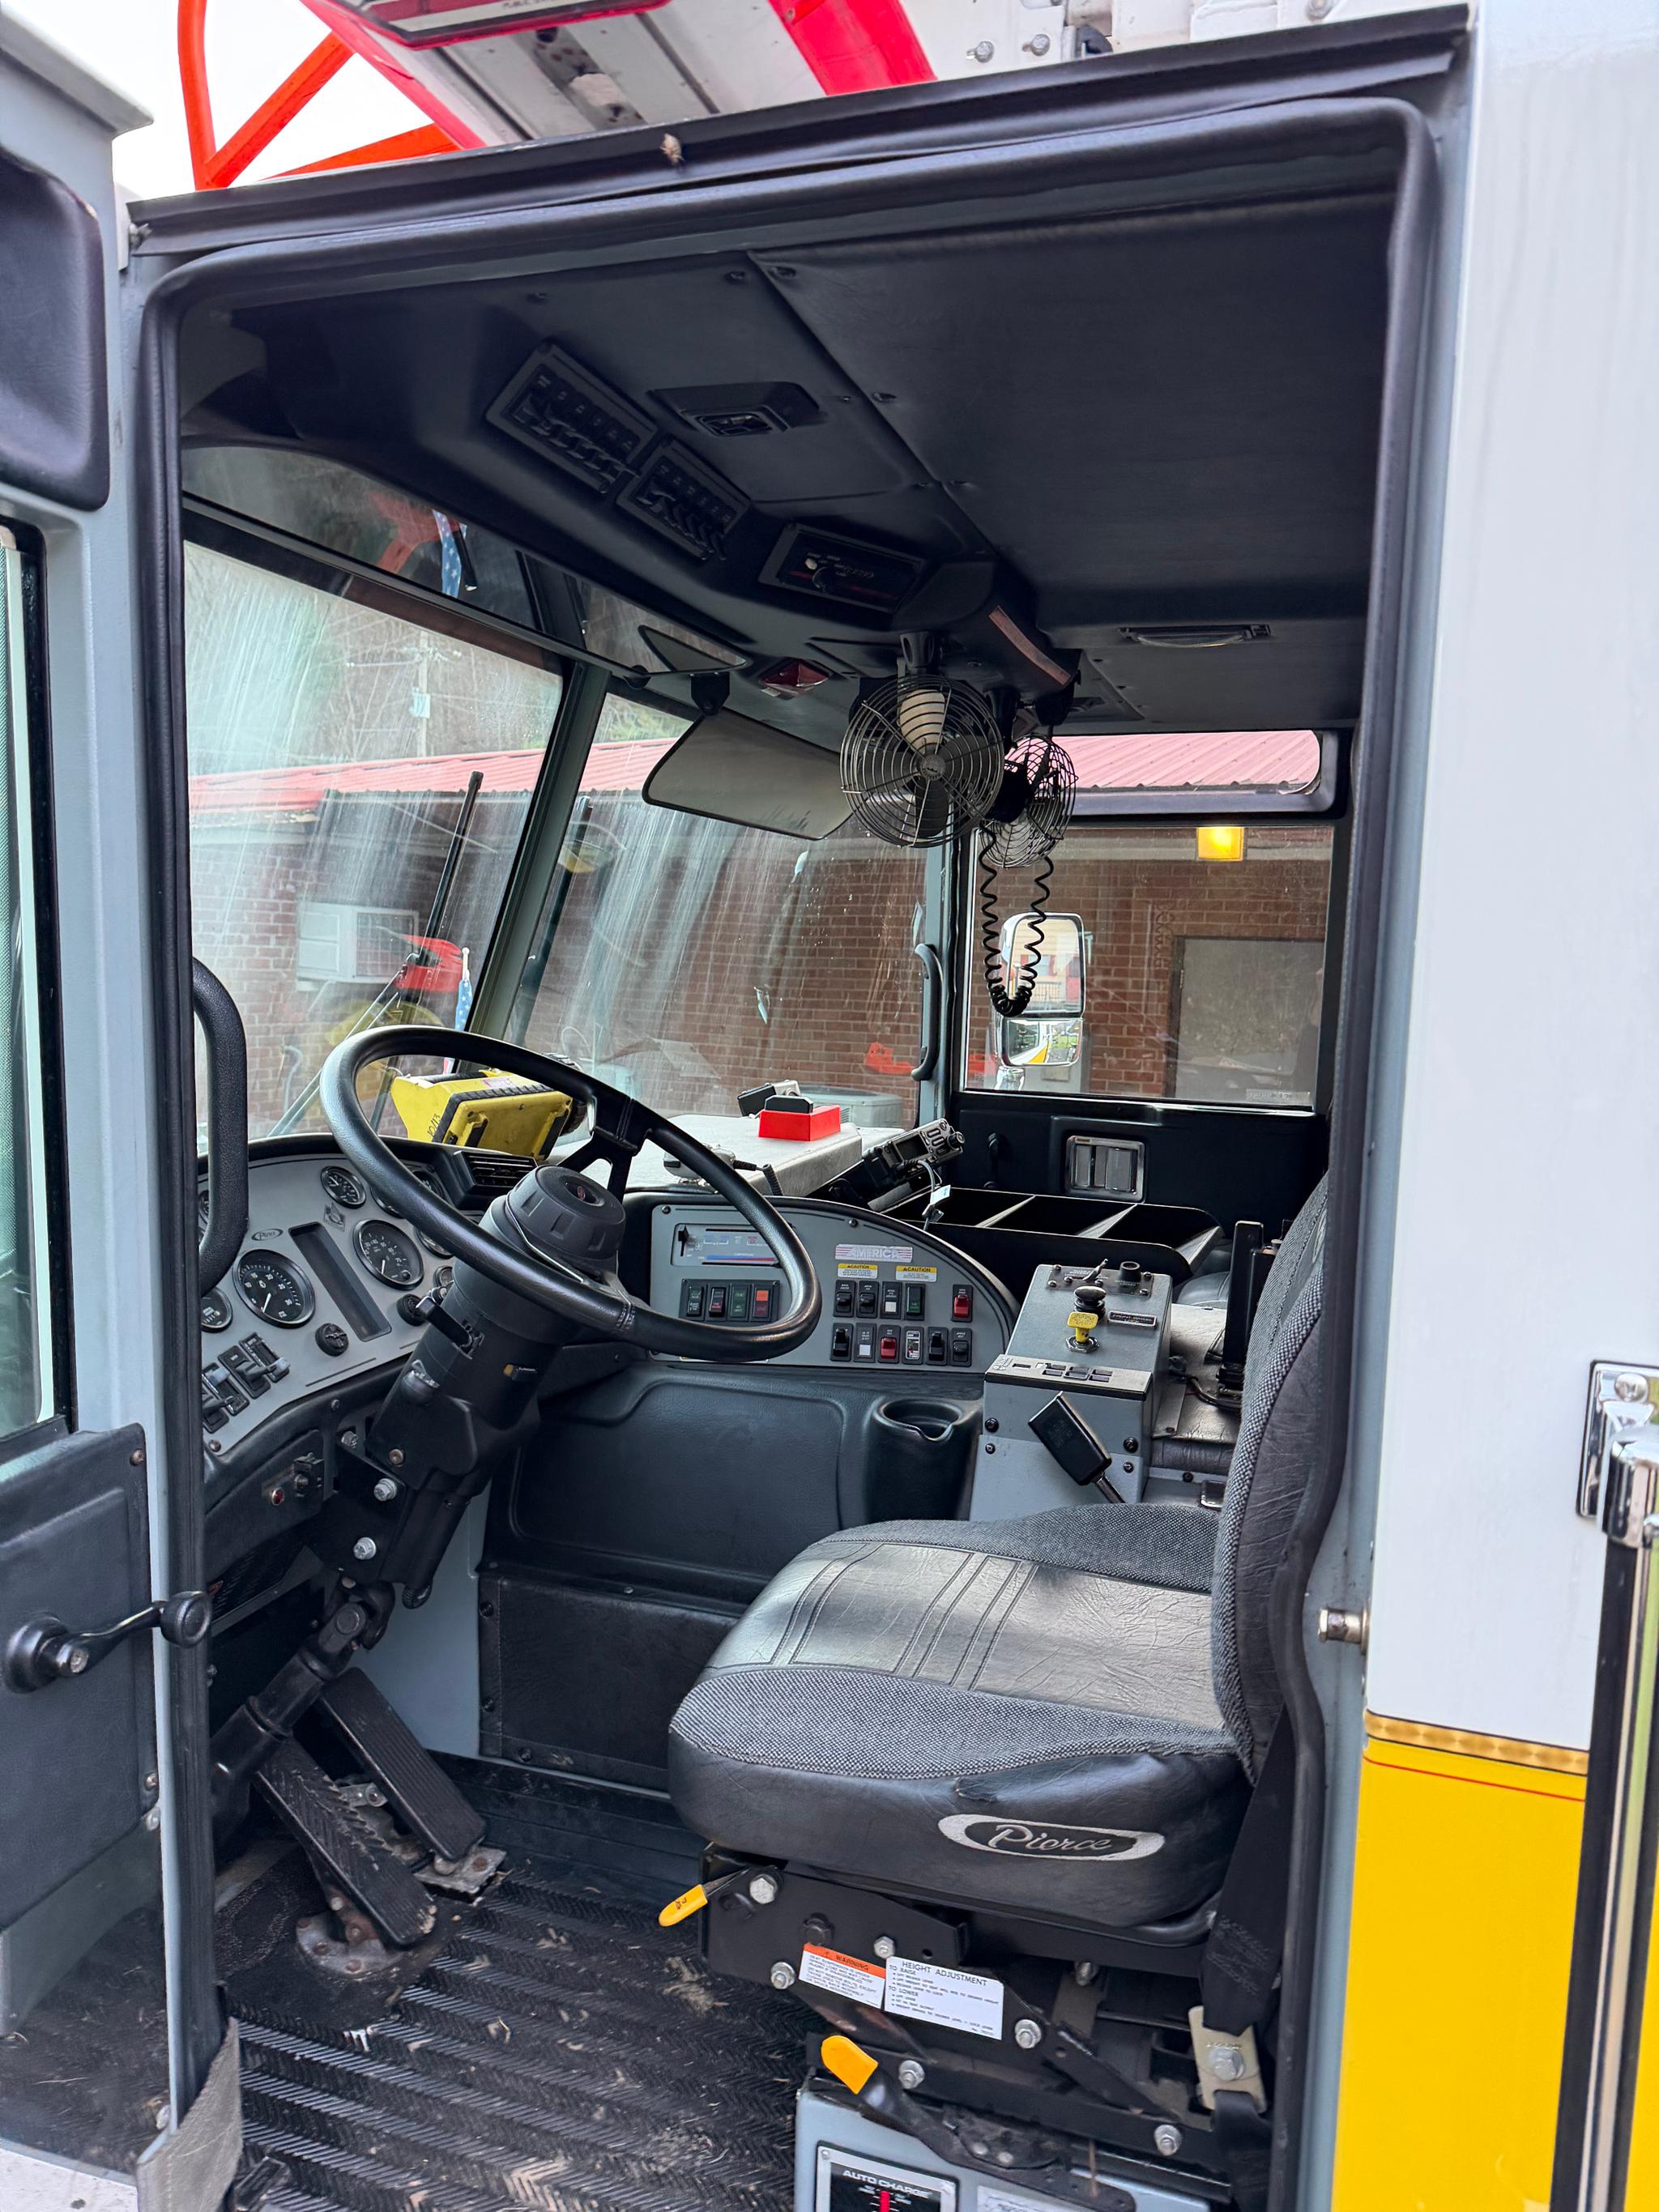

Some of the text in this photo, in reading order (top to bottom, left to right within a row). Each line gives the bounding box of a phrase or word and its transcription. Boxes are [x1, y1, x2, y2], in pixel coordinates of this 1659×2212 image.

[987, 1824, 1113, 1851] Pierce
[836, 1954, 869, 1971] WARNING
[902, 1961, 931, 1974] HEIGHT
[935, 1969, 987, 1986] ADJUSTMENT
[842, 2170, 876, 2185] AUTO
[878, 2179, 931, 2198] CHARGE
